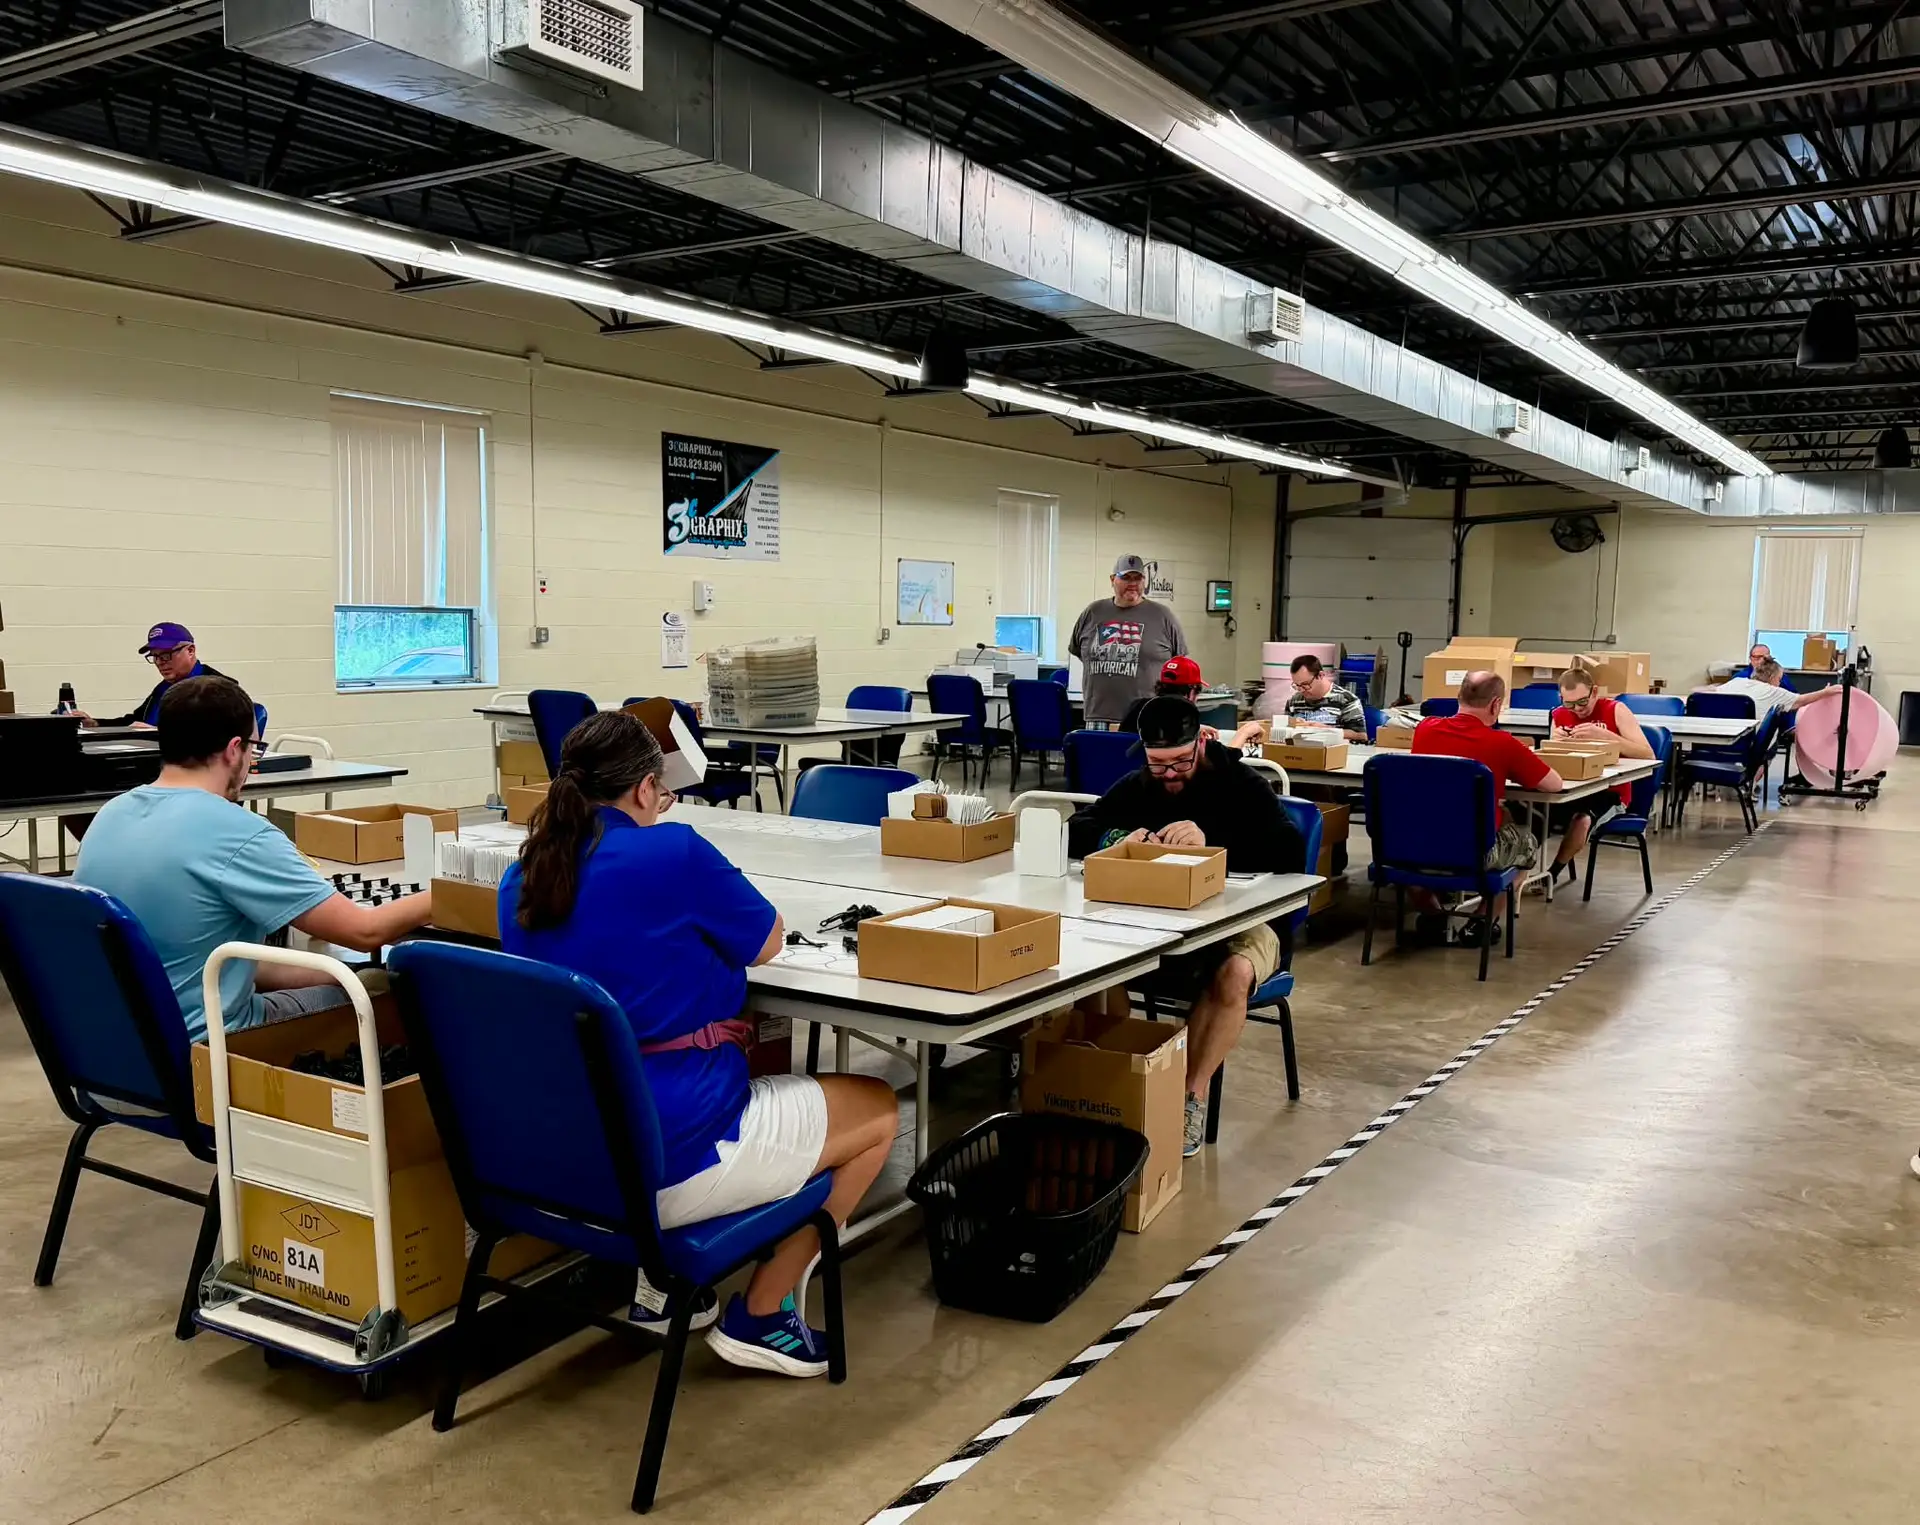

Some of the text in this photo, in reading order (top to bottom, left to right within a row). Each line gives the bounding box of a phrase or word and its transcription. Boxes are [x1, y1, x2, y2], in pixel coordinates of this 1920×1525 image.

[690, 517, 743, 538] GRAPHIX
[1090, 660, 1138, 678] NUYORICAN
[1010, 946, 1024, 957] TOTE
[1043, 1091, 1122, 1117] Viking Plastics
[298, 1213, 320, 1231] JDT
[252, 1244, 320, 1274] C/NO. 81A
[252, 1265, 350, 1307] MADE IN THAILAND
